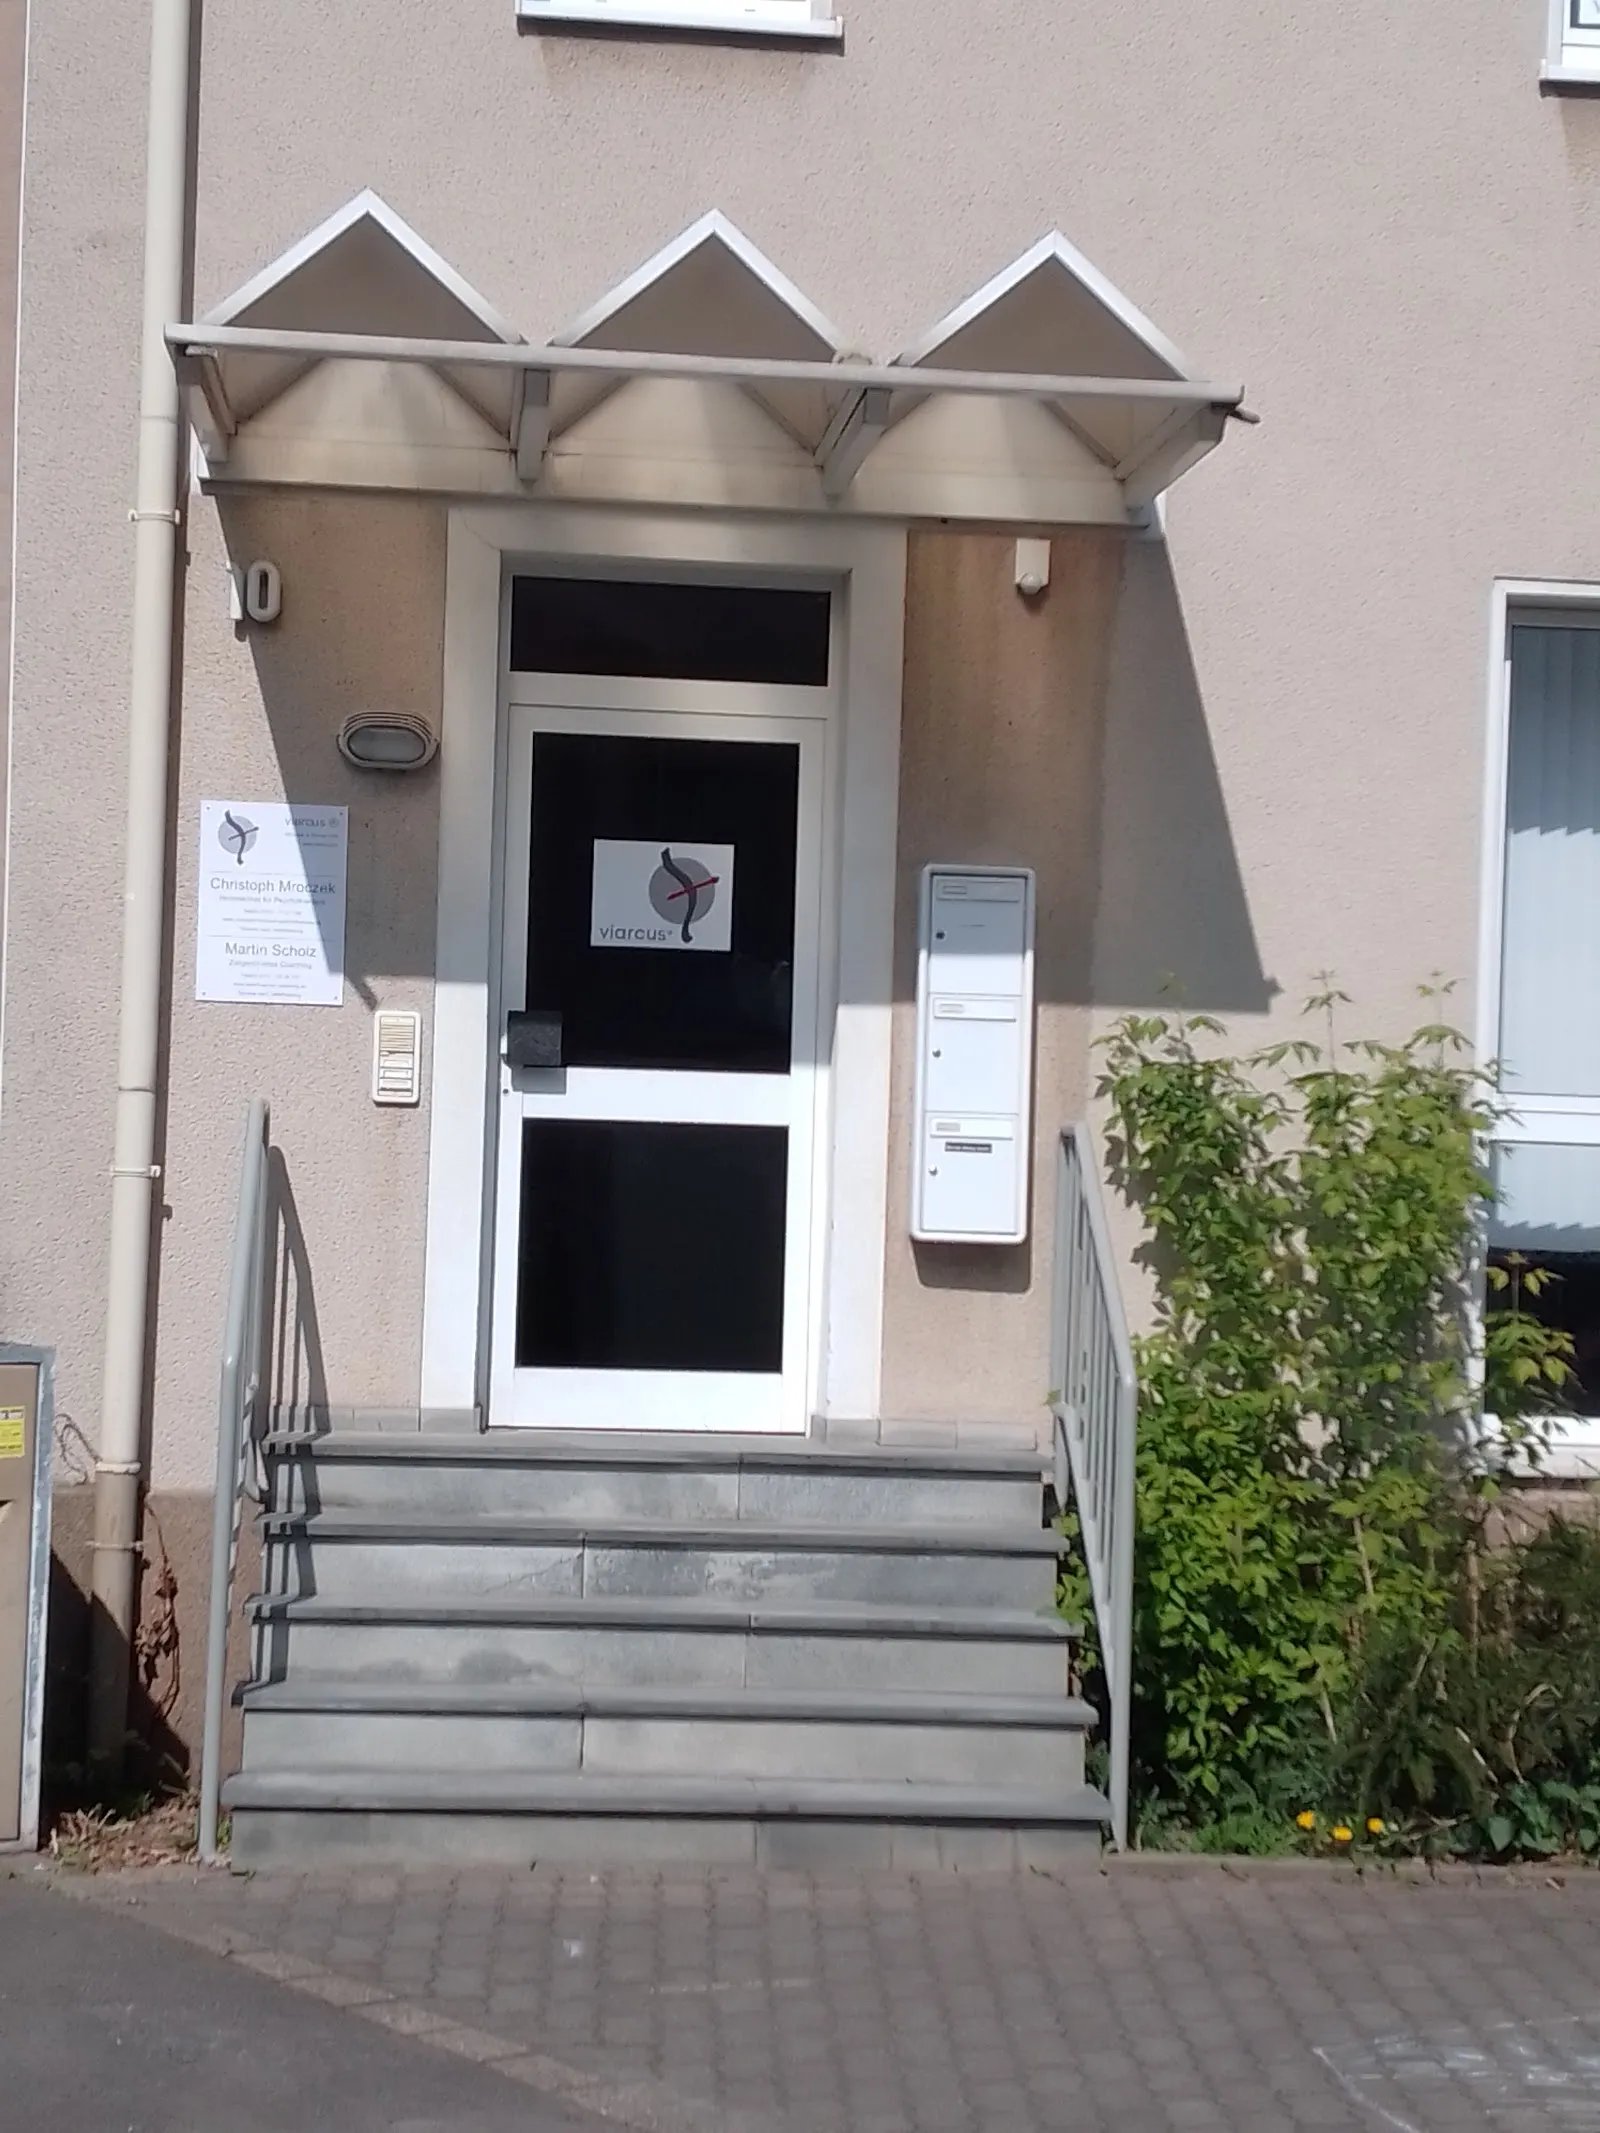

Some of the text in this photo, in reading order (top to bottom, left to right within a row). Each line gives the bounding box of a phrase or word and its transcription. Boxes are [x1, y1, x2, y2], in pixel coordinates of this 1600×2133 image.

[210, 877, 336, 894] Christoph Mroczek
[225, 942, 317, 957] Martin Scholz
